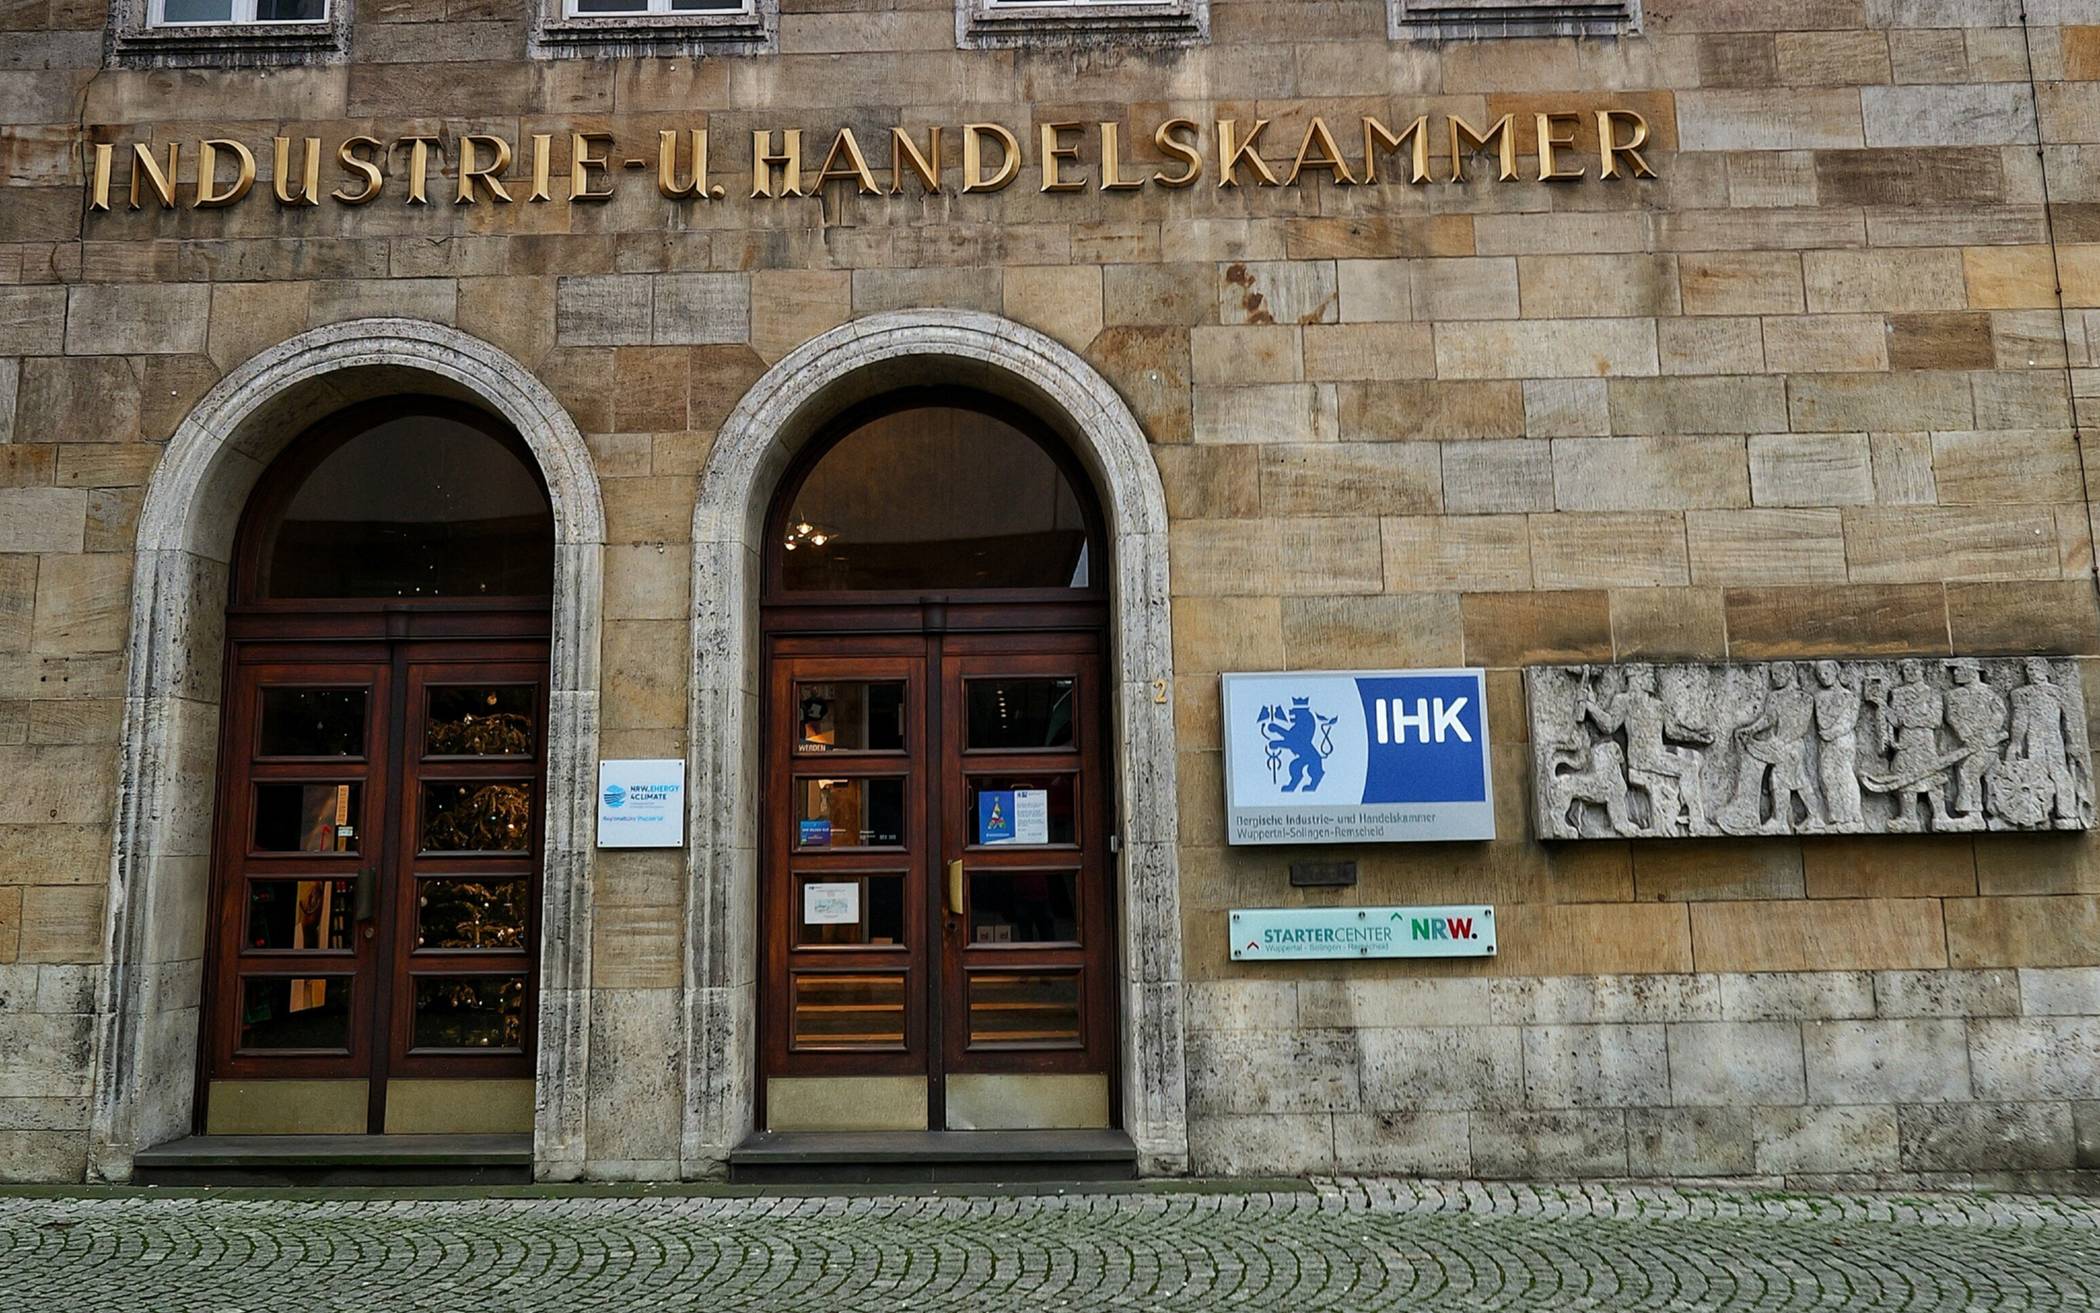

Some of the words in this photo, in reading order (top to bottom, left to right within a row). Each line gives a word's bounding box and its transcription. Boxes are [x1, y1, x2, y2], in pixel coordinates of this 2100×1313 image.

[750, 108, 1658, 199] HANDELSKAMMER
[1153, 678, 1168, 704] 2
[1375, 697, 1472, 744] IHK
[1236, 814, 1283, 827] Bergische
[1286, 813, 1335, 825] Industrie-
[1337, 813, 1356, 824] und
[1359, 812, 1437, 824] Handelskammer
[1236, 826, 1385, 841] Wuppertal-Solingen-Remscheid
[1264, 926, 1392, 943] STARTERCENTER
[1411, 918, 1478, 941] NRW.
